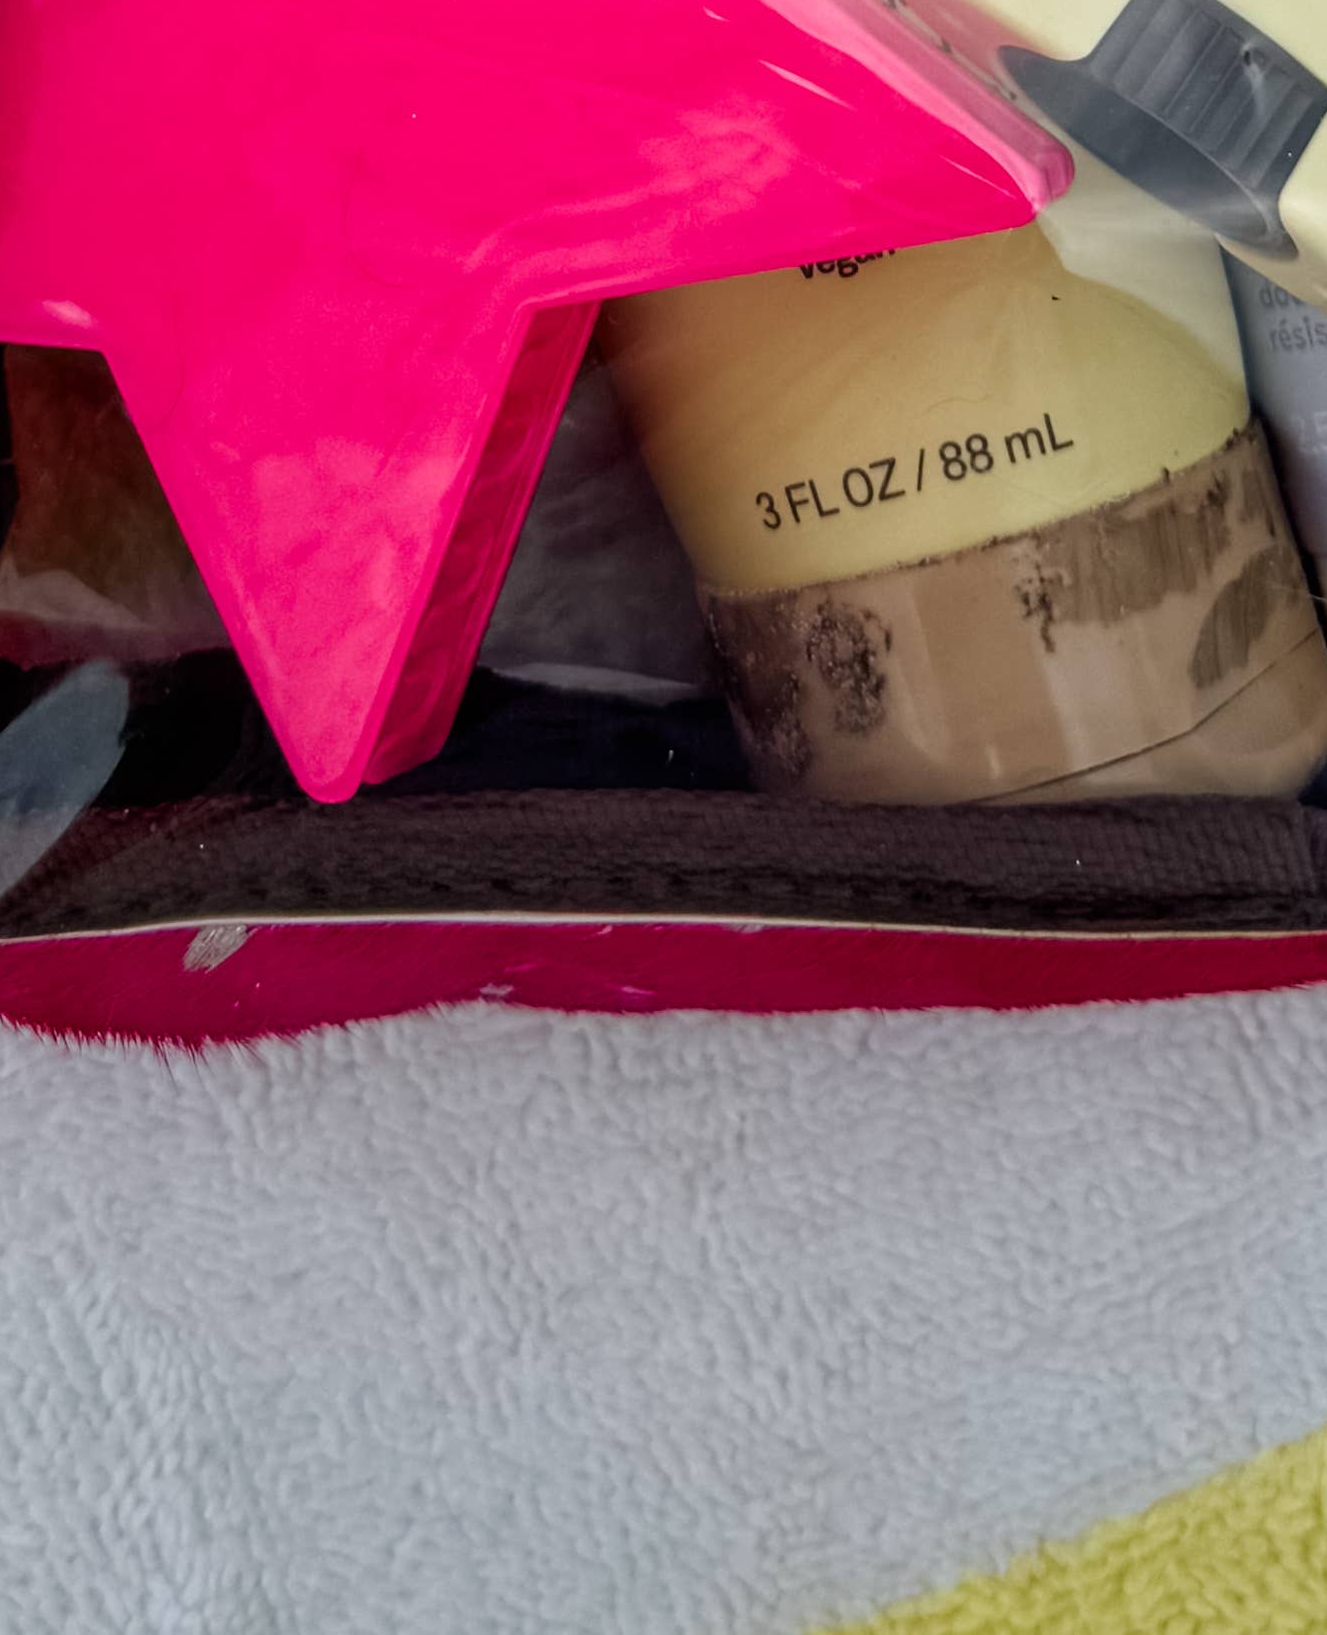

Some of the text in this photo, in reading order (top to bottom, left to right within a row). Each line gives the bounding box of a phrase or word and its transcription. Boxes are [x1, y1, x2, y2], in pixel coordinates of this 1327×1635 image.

[755, 491, 782, 531] 3
[784, 478, 841, 524] FL
[842, 457, 906, 508] OZ
[938, 433, 995, 482] 88
[1004, 412, 1075, 464] mL
